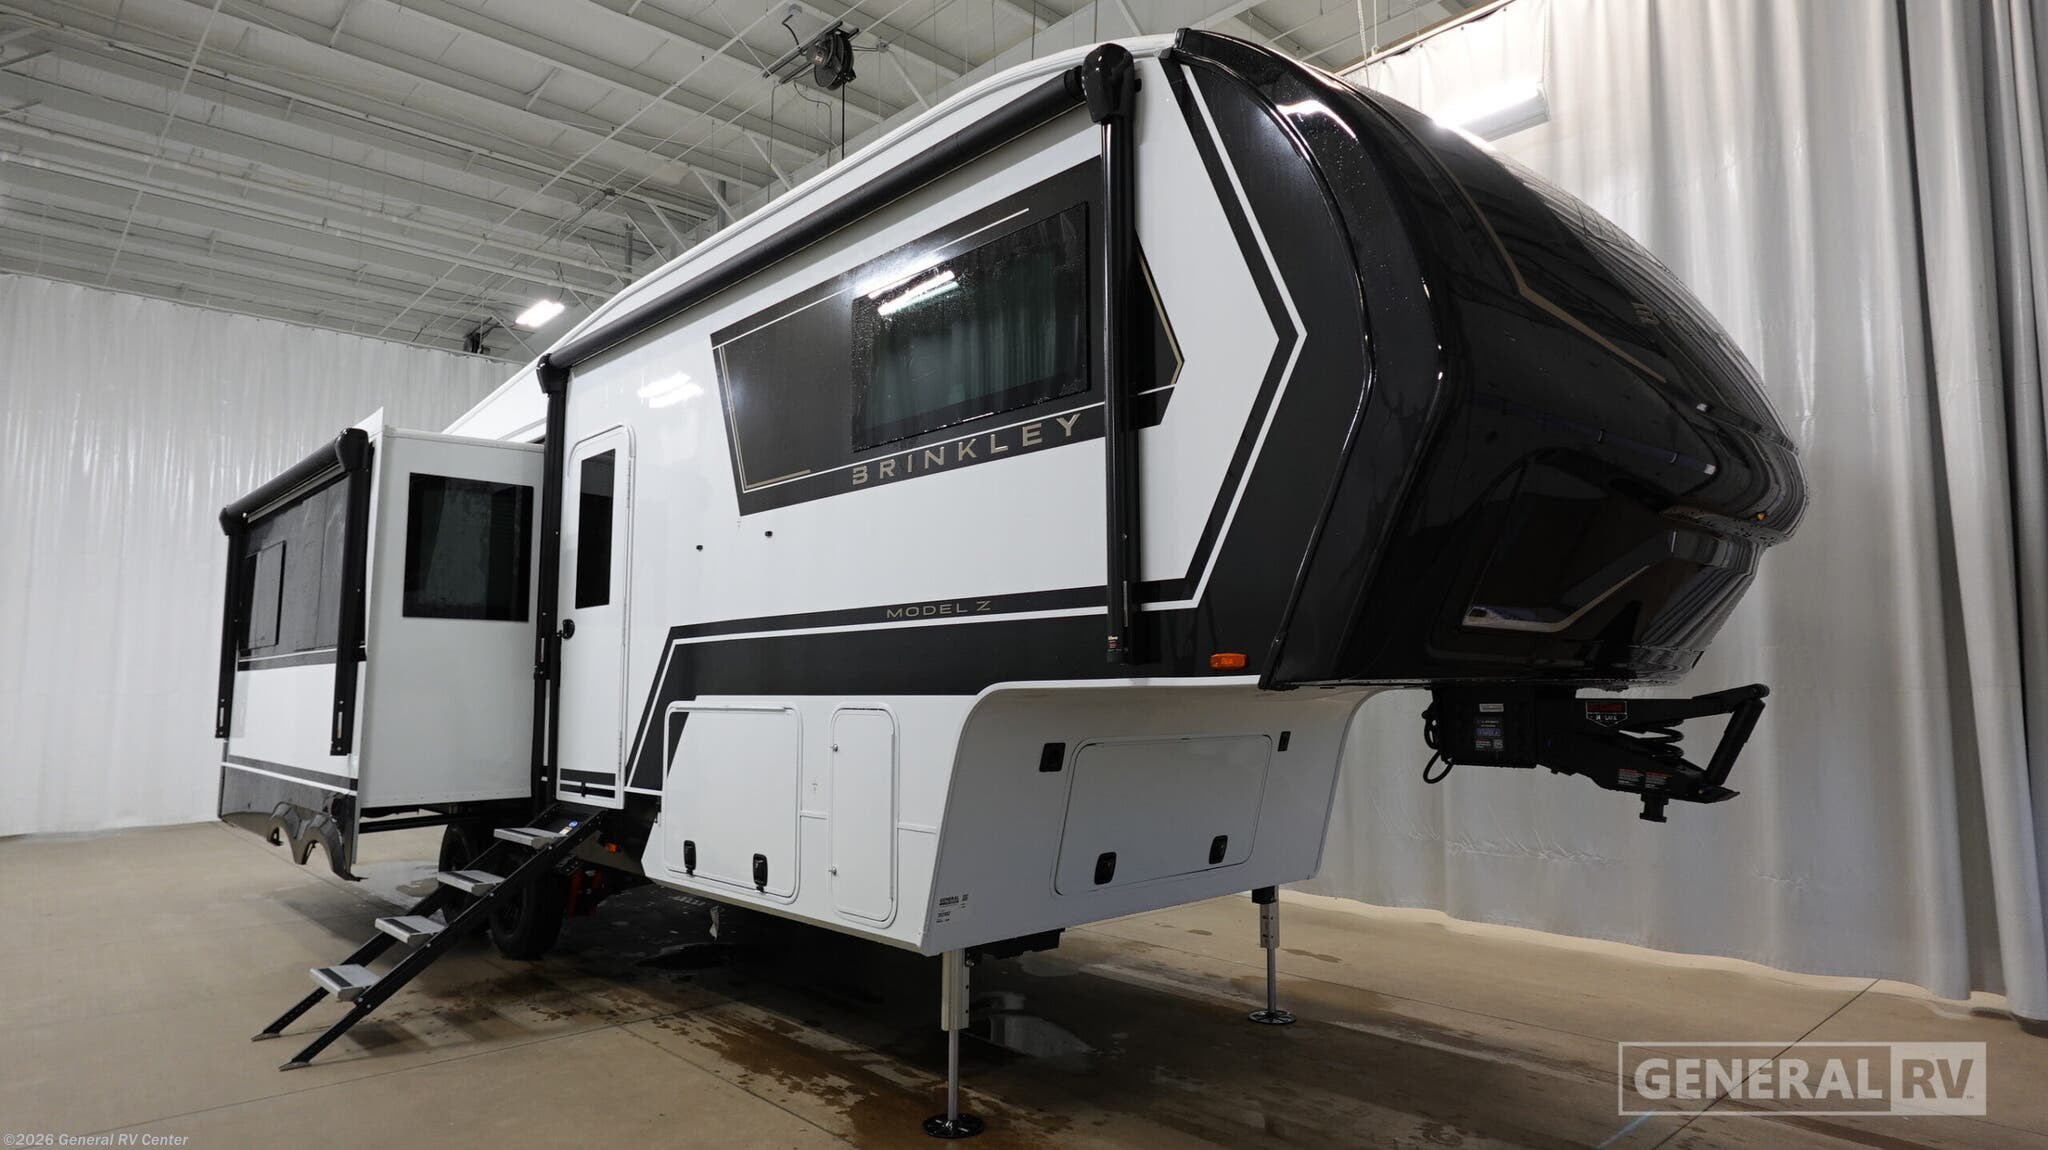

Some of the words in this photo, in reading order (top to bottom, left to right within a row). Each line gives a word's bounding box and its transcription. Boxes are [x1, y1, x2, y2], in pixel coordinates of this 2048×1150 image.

[852, 413, 1081, 485] BRINKLEY
[886, 602, 968, 619] MODEL
[976, 600, 992, 612] Z
